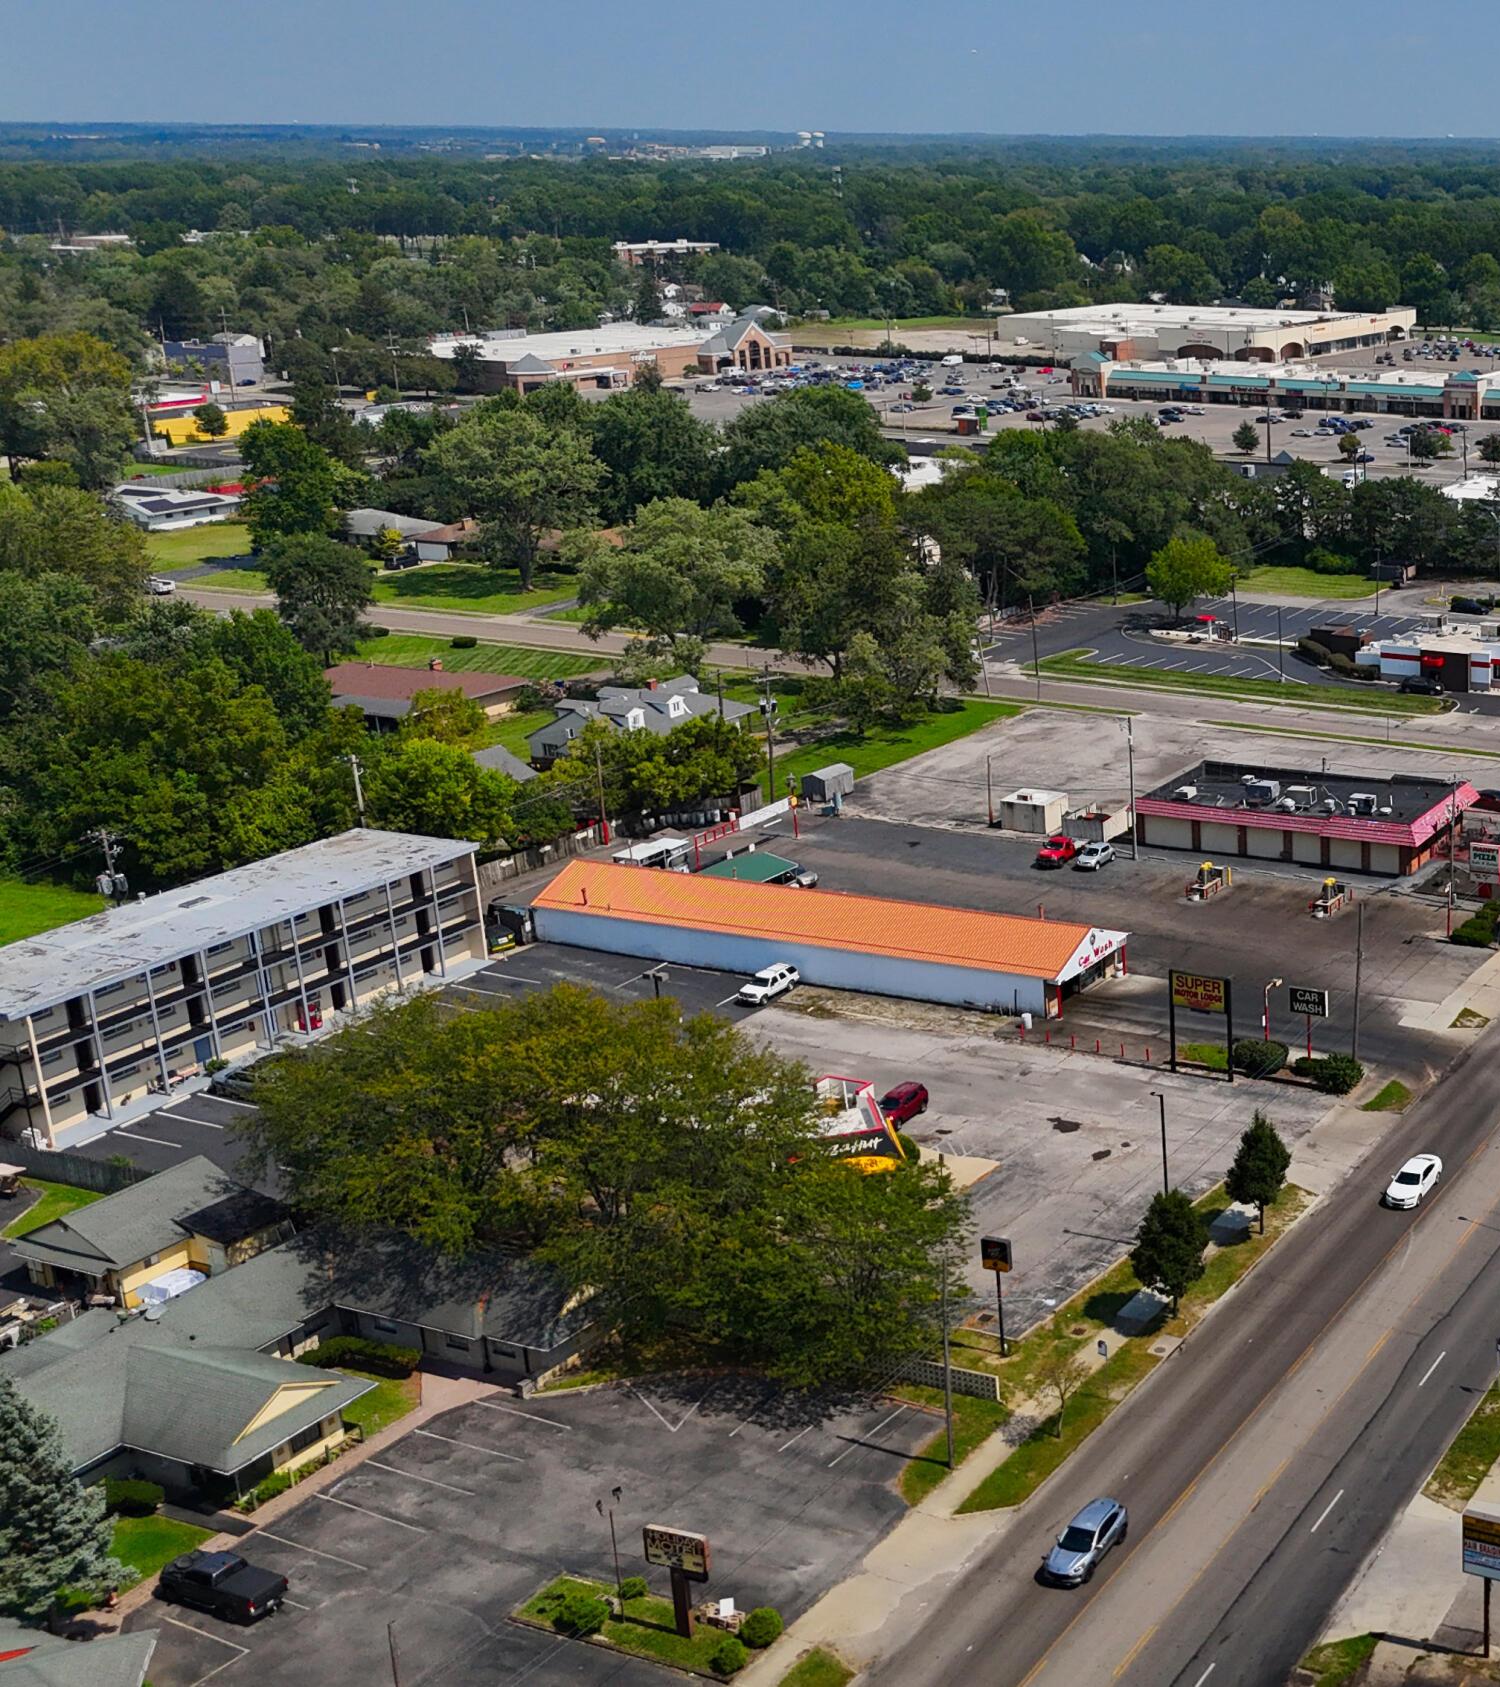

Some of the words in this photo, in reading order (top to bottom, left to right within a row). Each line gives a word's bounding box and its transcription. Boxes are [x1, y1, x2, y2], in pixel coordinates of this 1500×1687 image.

[1474, 853, 1497, 861] PIZZA
[1078, 954, 1091, 967] Car
[1093, 939, 1113, 957] Wash
[1176, 976, 1221, 993] SUPER
[1296, 990, 1319, 1002] CAR
[1292, 1001, 1323, 1014] WASH
[648, 1530, 698, 1546] HOLIDAY
[646, 1538, 698, 1556] MOTEL
